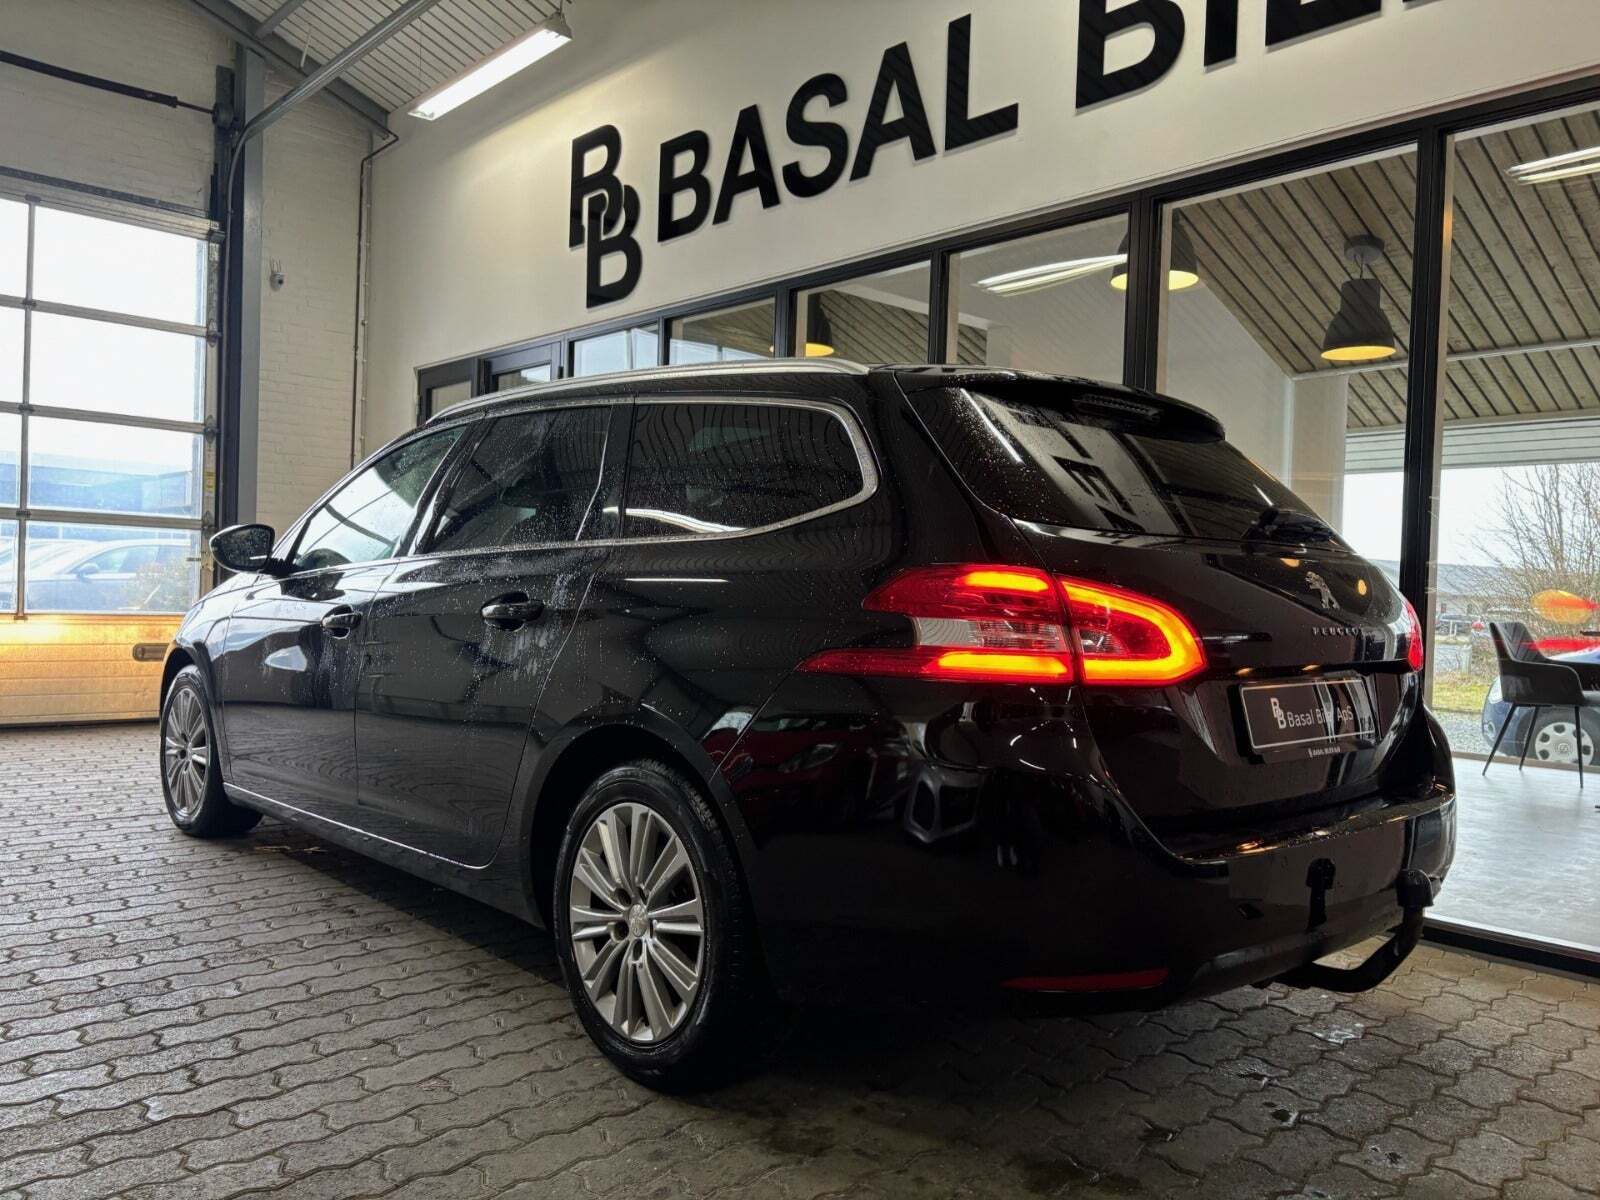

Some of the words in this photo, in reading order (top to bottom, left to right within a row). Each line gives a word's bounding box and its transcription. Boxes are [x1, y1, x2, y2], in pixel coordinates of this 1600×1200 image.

[658, 13, 1019, 242] BASAL
[1287, 709, 1314, 727] Basal
[1337, 705, 1354, 725] ApS
